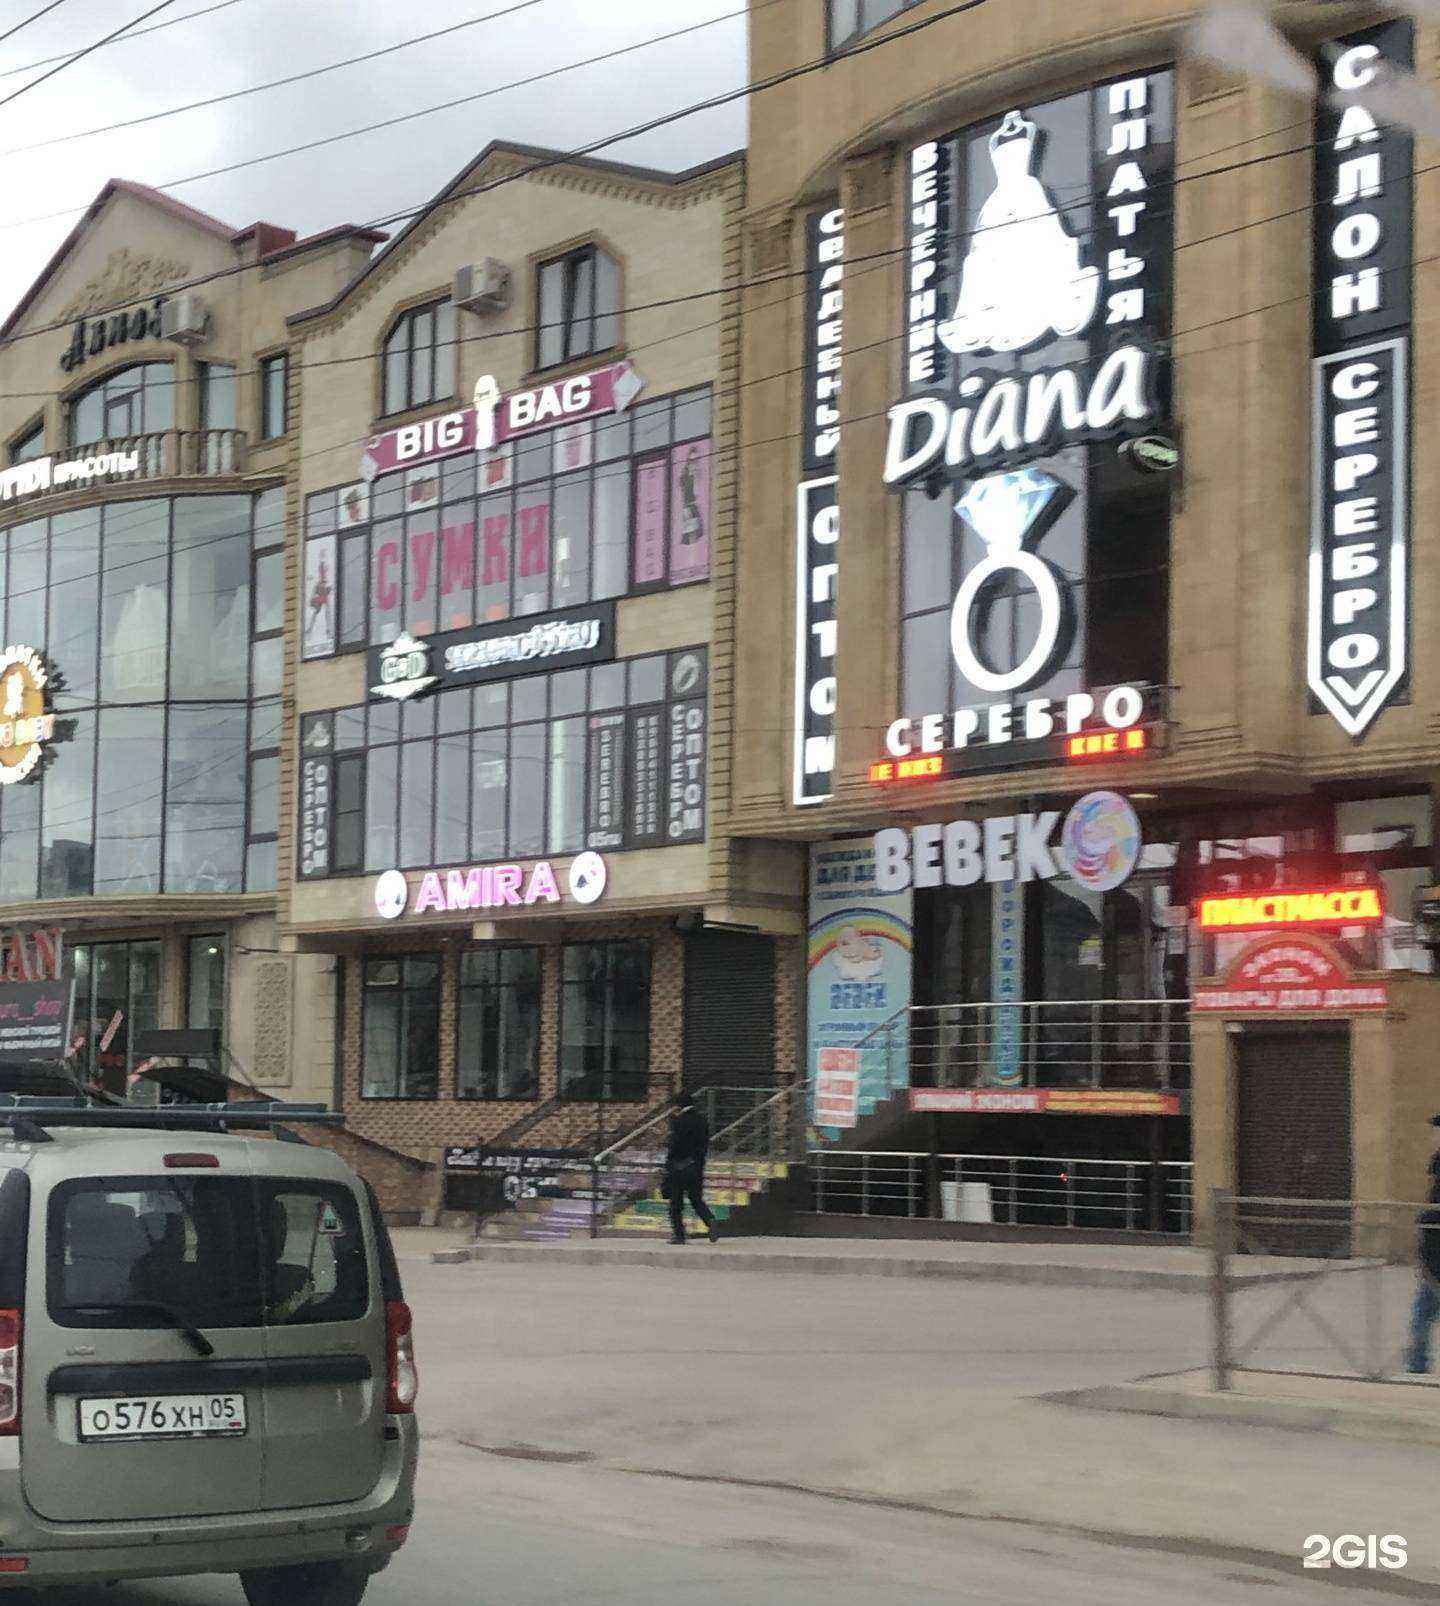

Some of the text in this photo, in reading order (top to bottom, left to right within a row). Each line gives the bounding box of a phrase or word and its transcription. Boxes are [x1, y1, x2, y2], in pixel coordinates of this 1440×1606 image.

[1106, 77, 1147, 325] ПЛАТЬЯ
[1332, 44, 1381, 319] САЛОН
[909, 141, 938, 383] ВЕЧЕРНИЕ
[396, 375, 591, 460] BIG BAG
[882, 345, 1149, 484] Diana
[376, 505, 548, 612] СУМКИ
[1327, 362, 1380, 669] СЕРЕБРО
[887, 686, 1143, 757] СЕРЕБРО
[415, 861, 561, 914] AMIRA
[873, 810, 1060, 892] BEBEK
